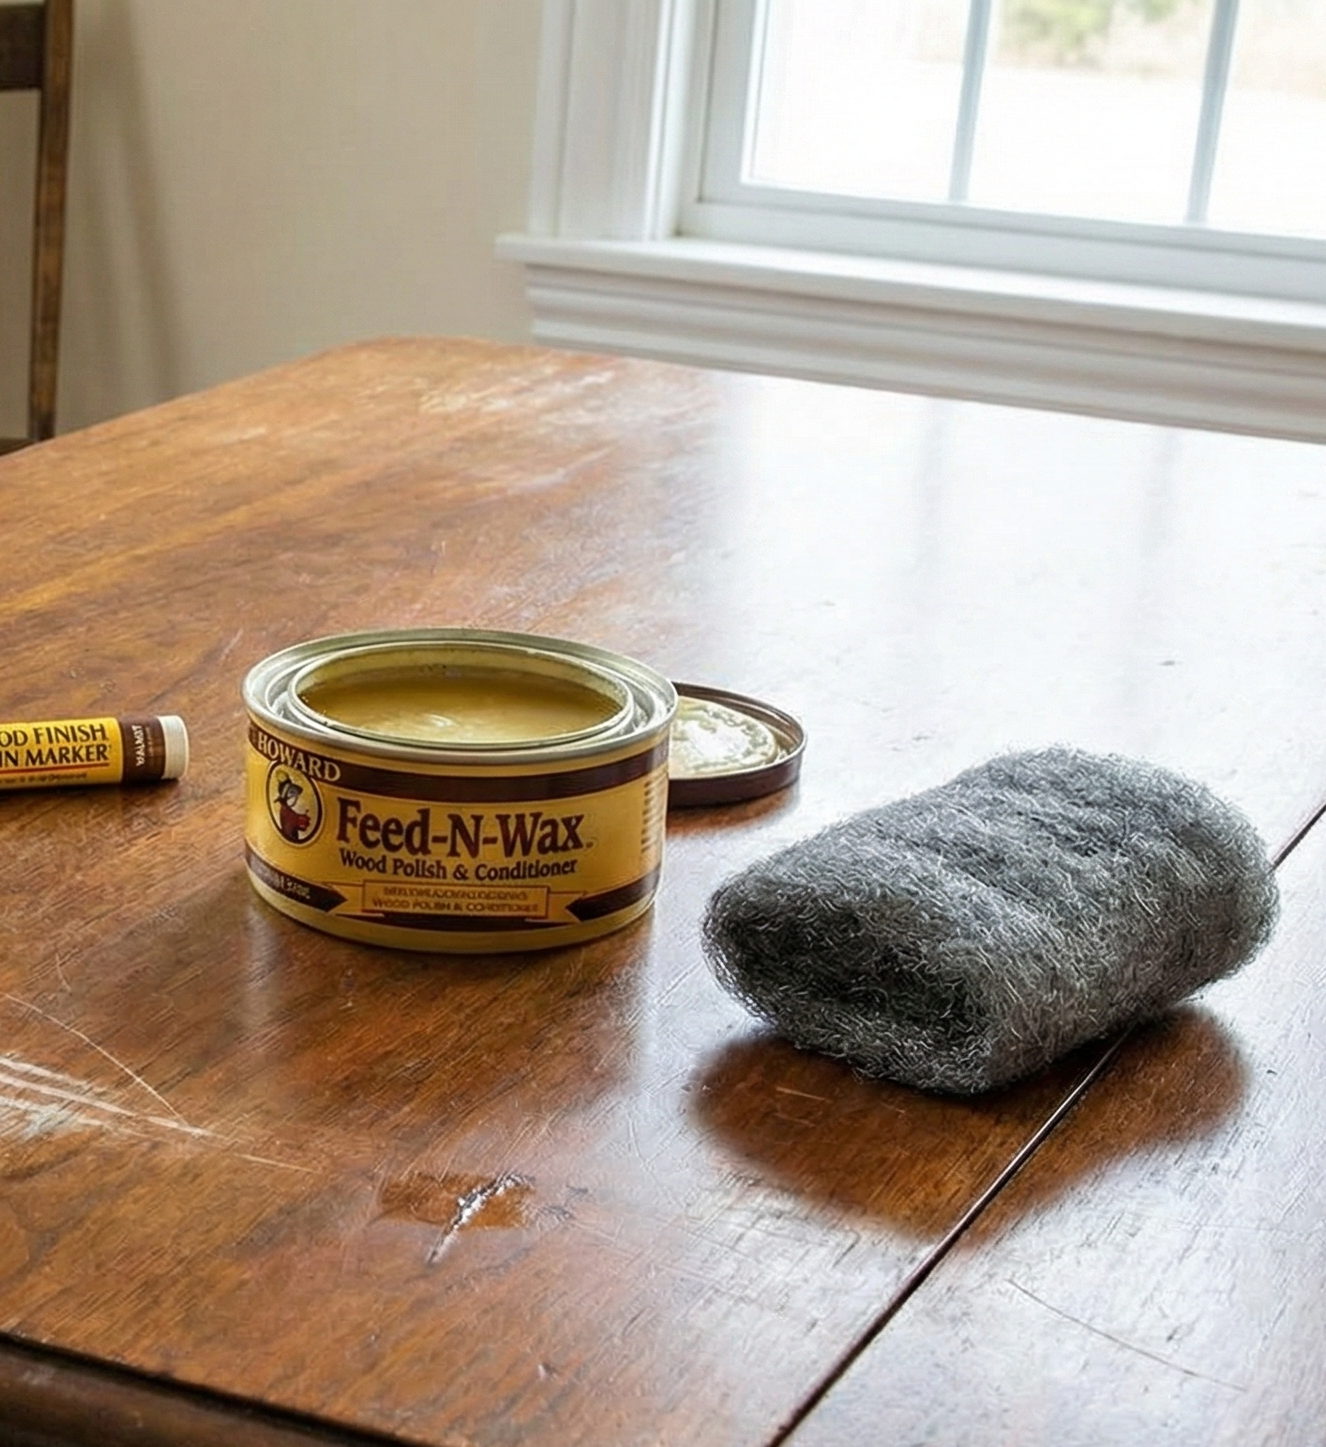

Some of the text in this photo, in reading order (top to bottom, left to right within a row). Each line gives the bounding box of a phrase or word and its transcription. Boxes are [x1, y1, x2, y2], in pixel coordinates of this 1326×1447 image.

[33, 723, 107, 744] FINISH
[25, 744, 109, 767] MARKER
[257, 731, 341, 782] HOWARD
[336, 796, 585, 859] Feed-N-Wax
[340, 847, 578, 881] Wood Polish & Conditioner
